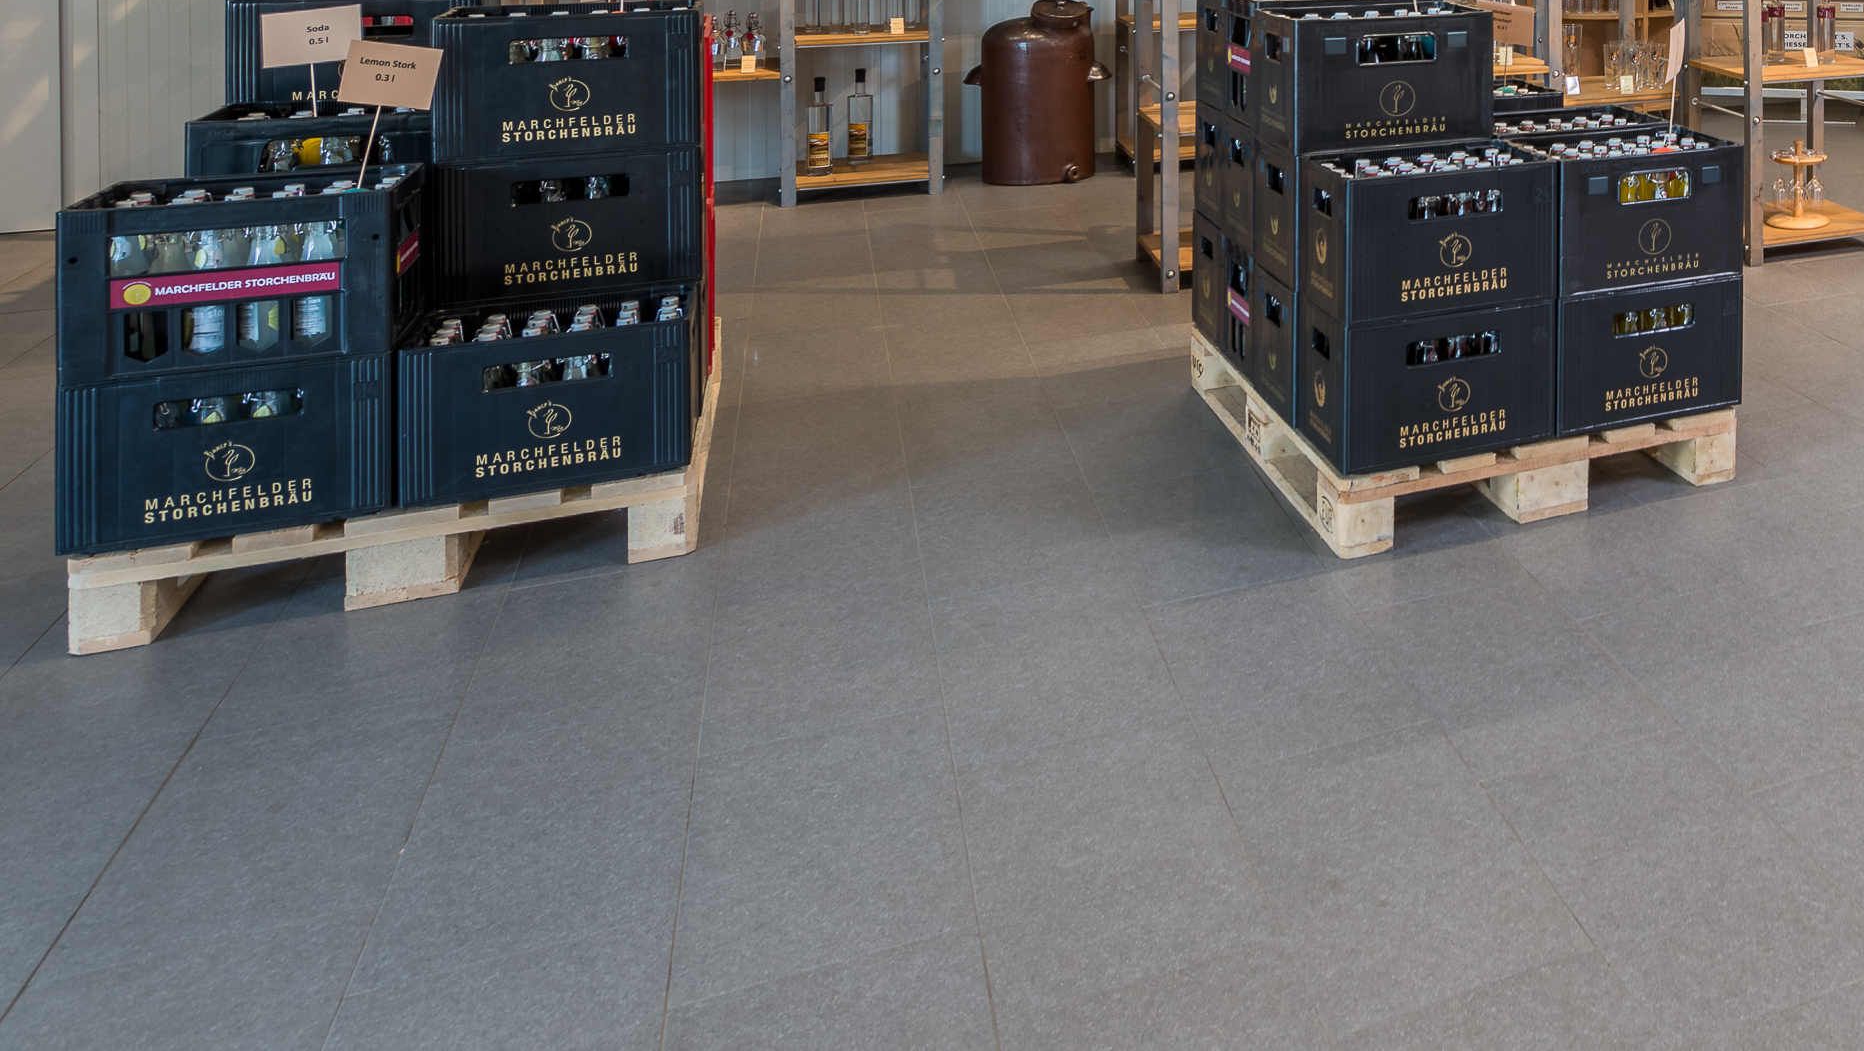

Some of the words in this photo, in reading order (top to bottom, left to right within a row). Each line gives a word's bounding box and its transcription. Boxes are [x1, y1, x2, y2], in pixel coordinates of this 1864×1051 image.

[306, 23, 330, 34] Soda
[308, 36, 325, 45] 0.5
[359, 56, 392, 69] Lemon
[393, 59, 417, 70] Stork
[374, 72, 391, 83] 0.3
[502, 122, 637, 143] STORCHENBRÄU
[503, 113, 636, 132] MARCHFELDER
[1345, 124, 1446, 139] STORCHENBRÄU
[504, 252, 638, 274] MARCHFELDER
[504, 261, 639, 285] STORCHENBRÄU
[1606, 260, 1699, 280] STORCHENBRÄU
[155, 279, 242, 296] MARCHFELDER
[244, 271, 336, 288] STORCHENBRÄU
[1400, 278, 1507, 302] STORCHENBRÄU
[1401, 267, 1507, 291] MARCHFELDER
[1605, 387, 1698, 412] STORCHENBRÄU
[1606, 376, 1698, 401] MARCHFELDER
[1399, 420, 1506, 448] STORCHENBRÄU
[1400, 408, 1506, 437] MARCHFELDER
[475, 444, 622, 478] STORCHENBRÄU
[476, 435, 622, 466] MARCHFELDER
[144, 488, 313, 524] STORCHENBRÄU
[145, 478, 313, 510] MARCHFELDER
